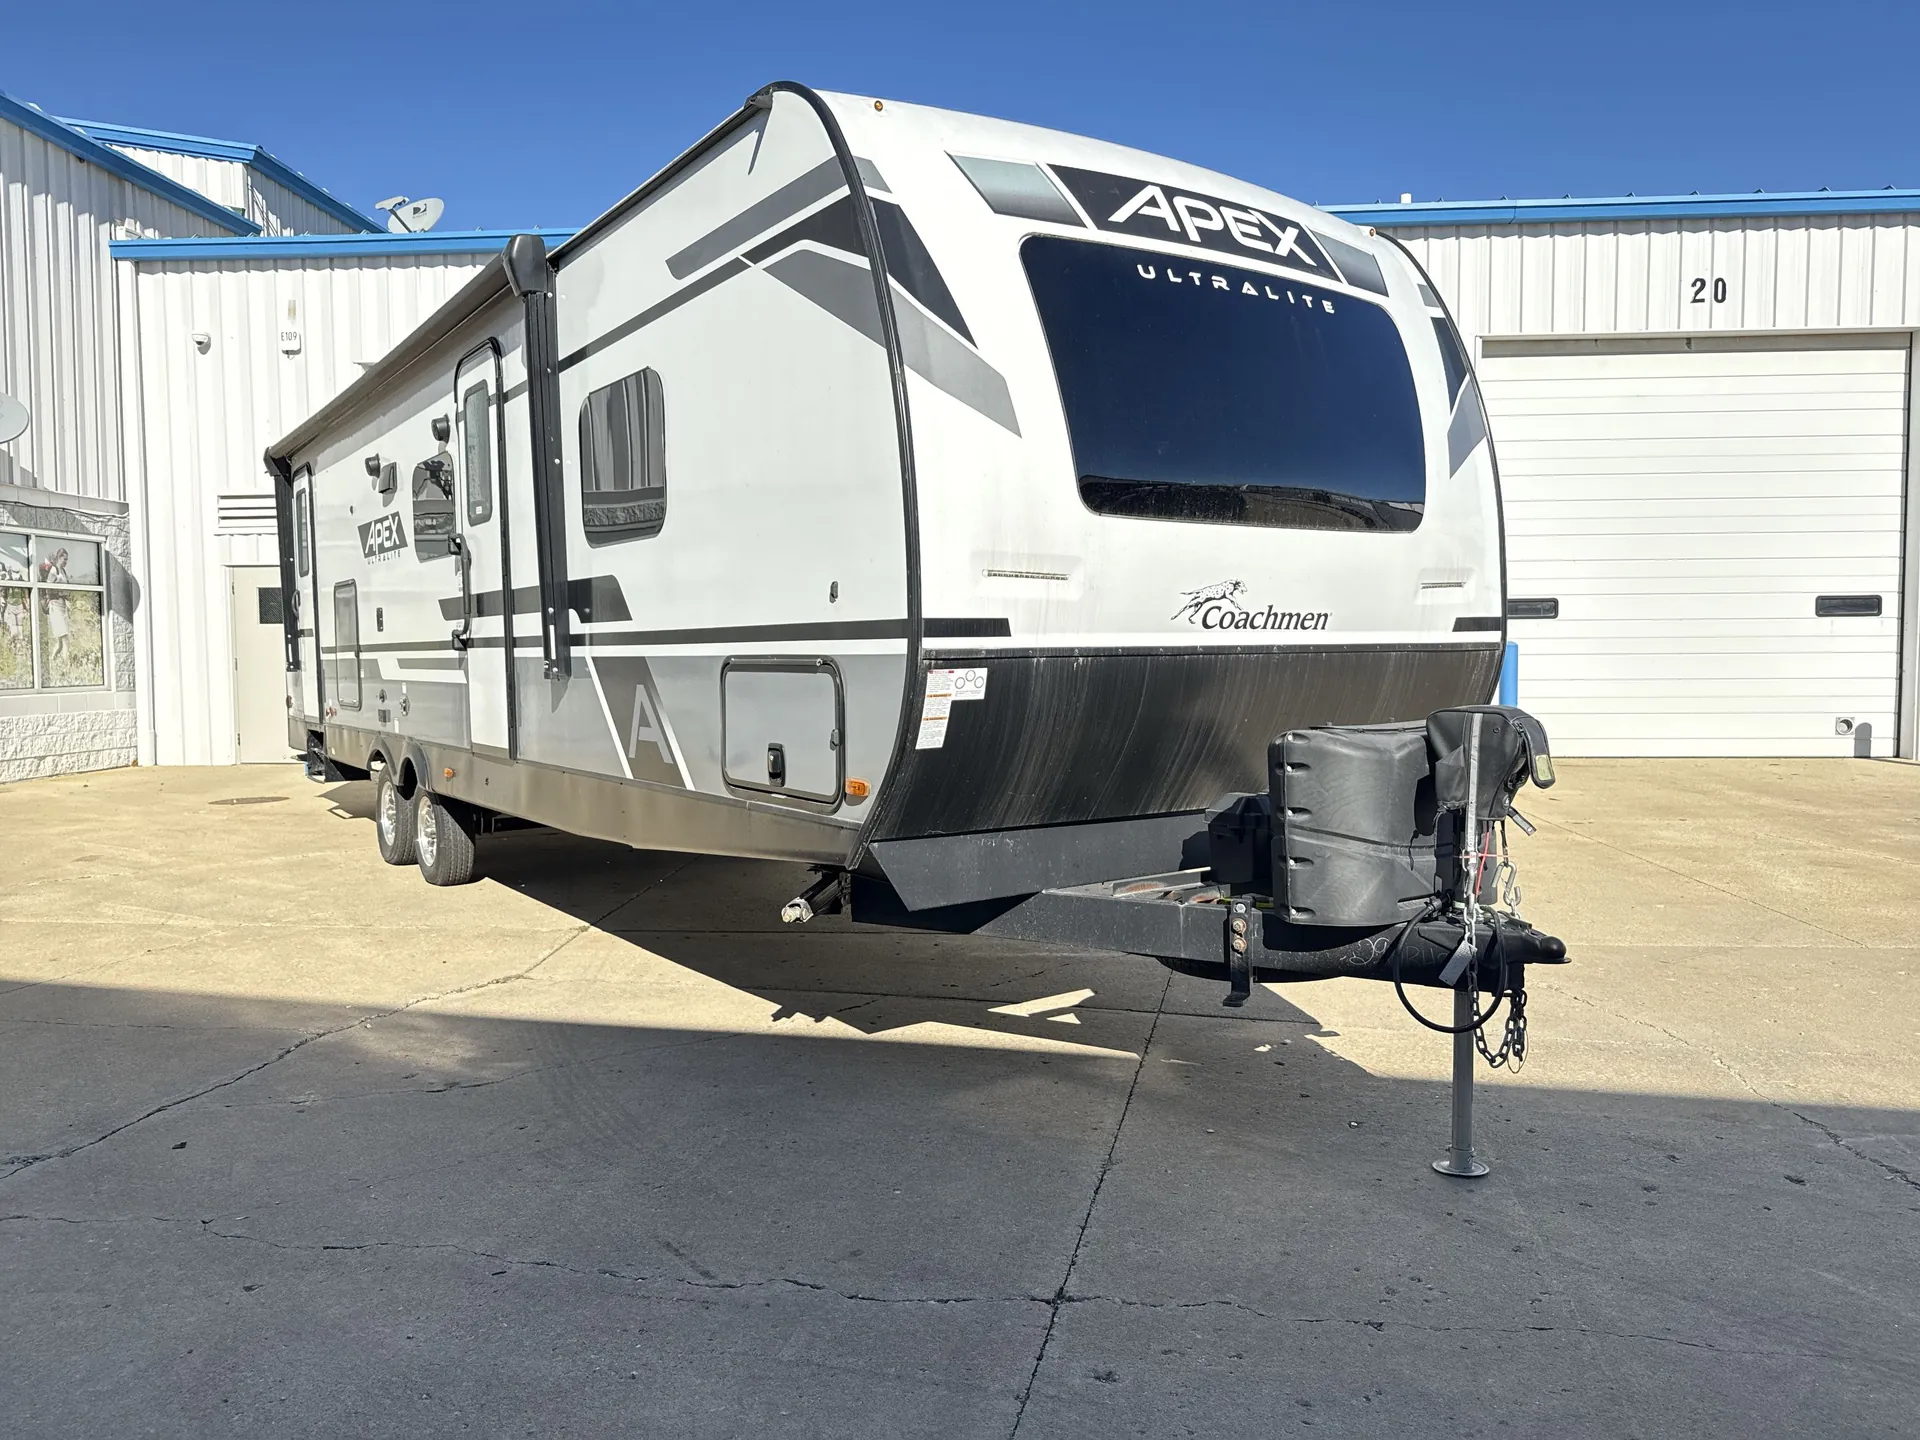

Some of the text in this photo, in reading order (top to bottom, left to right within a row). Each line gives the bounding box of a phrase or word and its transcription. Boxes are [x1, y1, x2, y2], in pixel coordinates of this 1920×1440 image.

[1108, 184, 1318, 267] APEX
[1136, 263, 1336, 315] ULTRALITE
[1690, 277, 1727, 304] 20
[280, 331, 298, 342] E109
[365, 514, 400, 555] APEX
[367, 549, 401, 565] ULTRALITE
[1201, 604, 1331, 631] Coachmen
[628, 684, 674, 764] A
